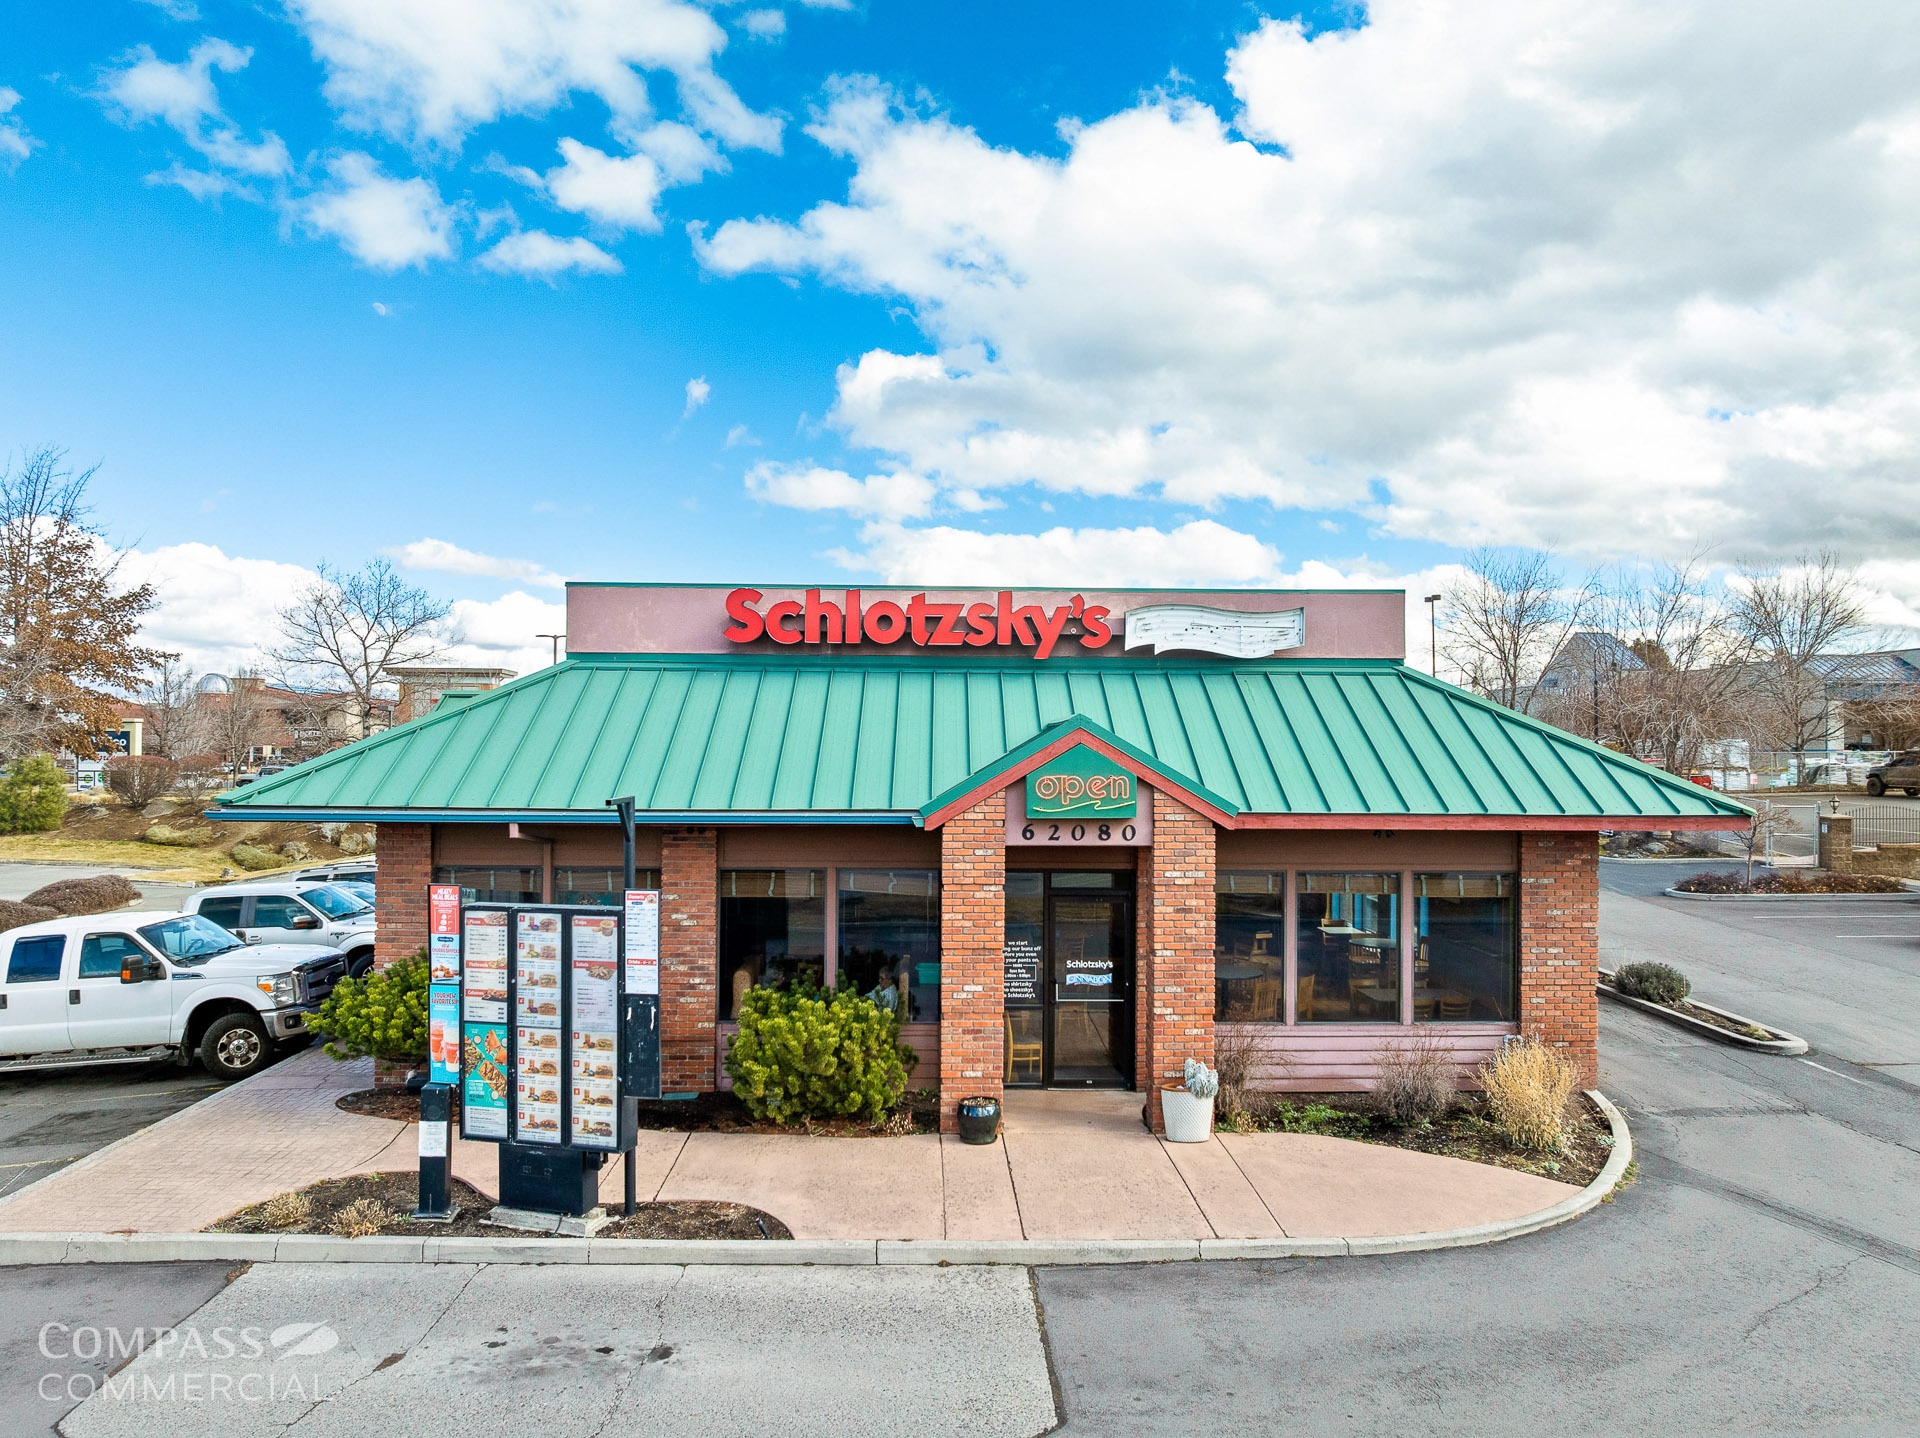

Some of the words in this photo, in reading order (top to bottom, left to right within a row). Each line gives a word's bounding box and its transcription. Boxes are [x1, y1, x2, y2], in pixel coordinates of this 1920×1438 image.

[723, 588, 1112, 660] Schlotzsky's
[1035, 774, 1129, 805] open
[1021, 823, 1137, 841] 62080
[1066, 960, 1114, 970] Schlotzsky's
